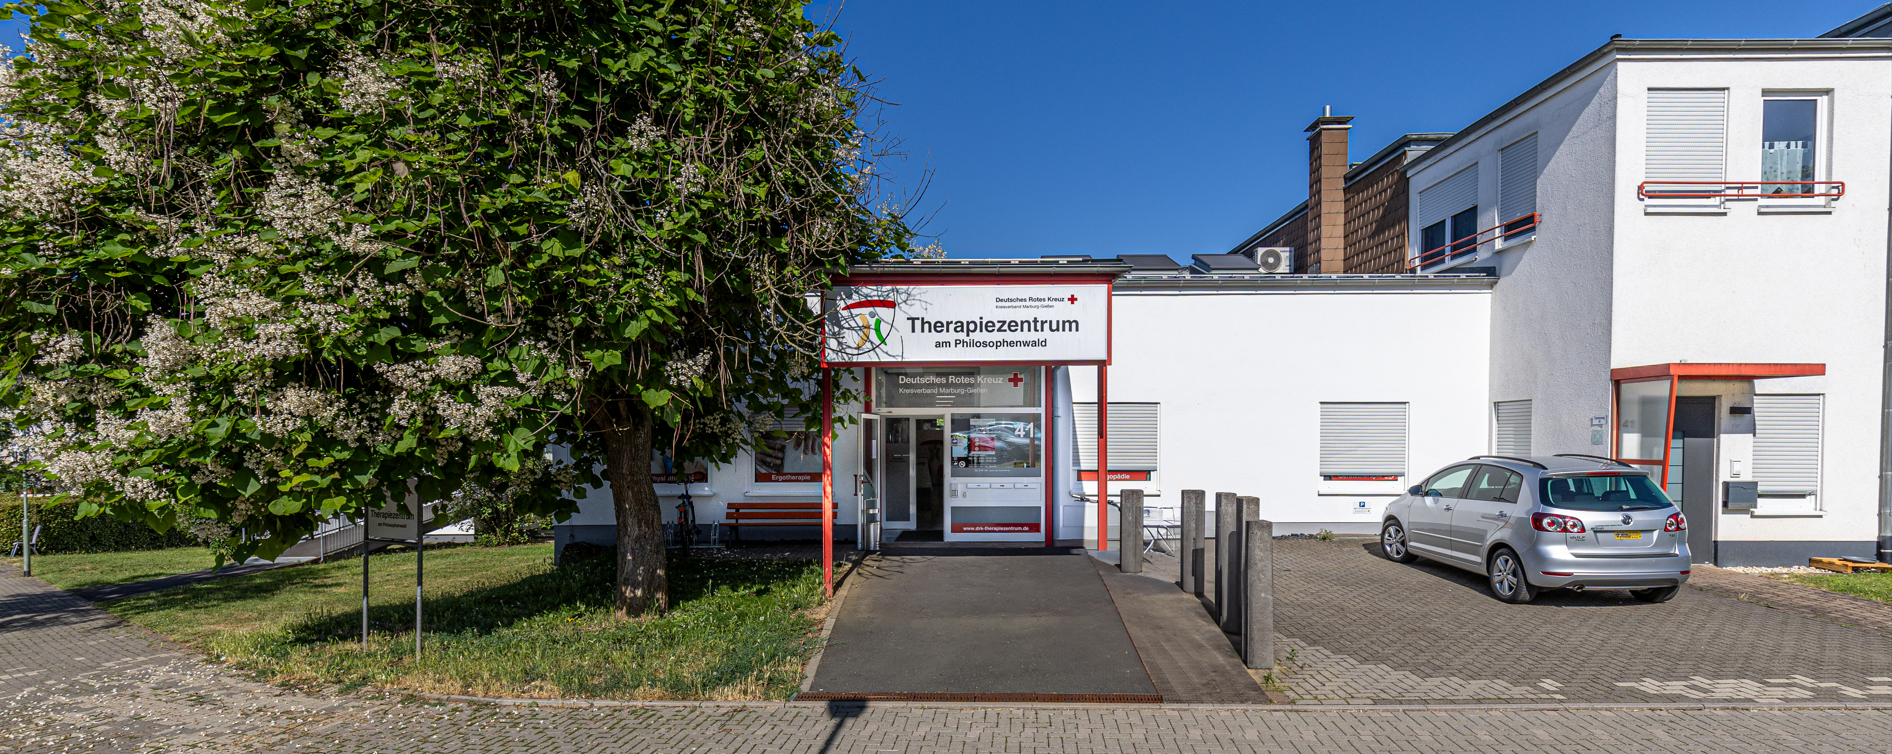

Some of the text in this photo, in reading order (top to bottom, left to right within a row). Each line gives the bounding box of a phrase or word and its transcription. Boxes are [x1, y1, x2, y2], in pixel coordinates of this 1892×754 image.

[906, 316, 1080, 337] Therapiezentrum
[934, 338, 1047, 350] am Philosophenwald
[898, 375, 1004, 384] Deutsches Rotes Kreuz
[939, 387, 988, 395] Marburg-Gießen
[1014, 422, 1034, 438] 41
